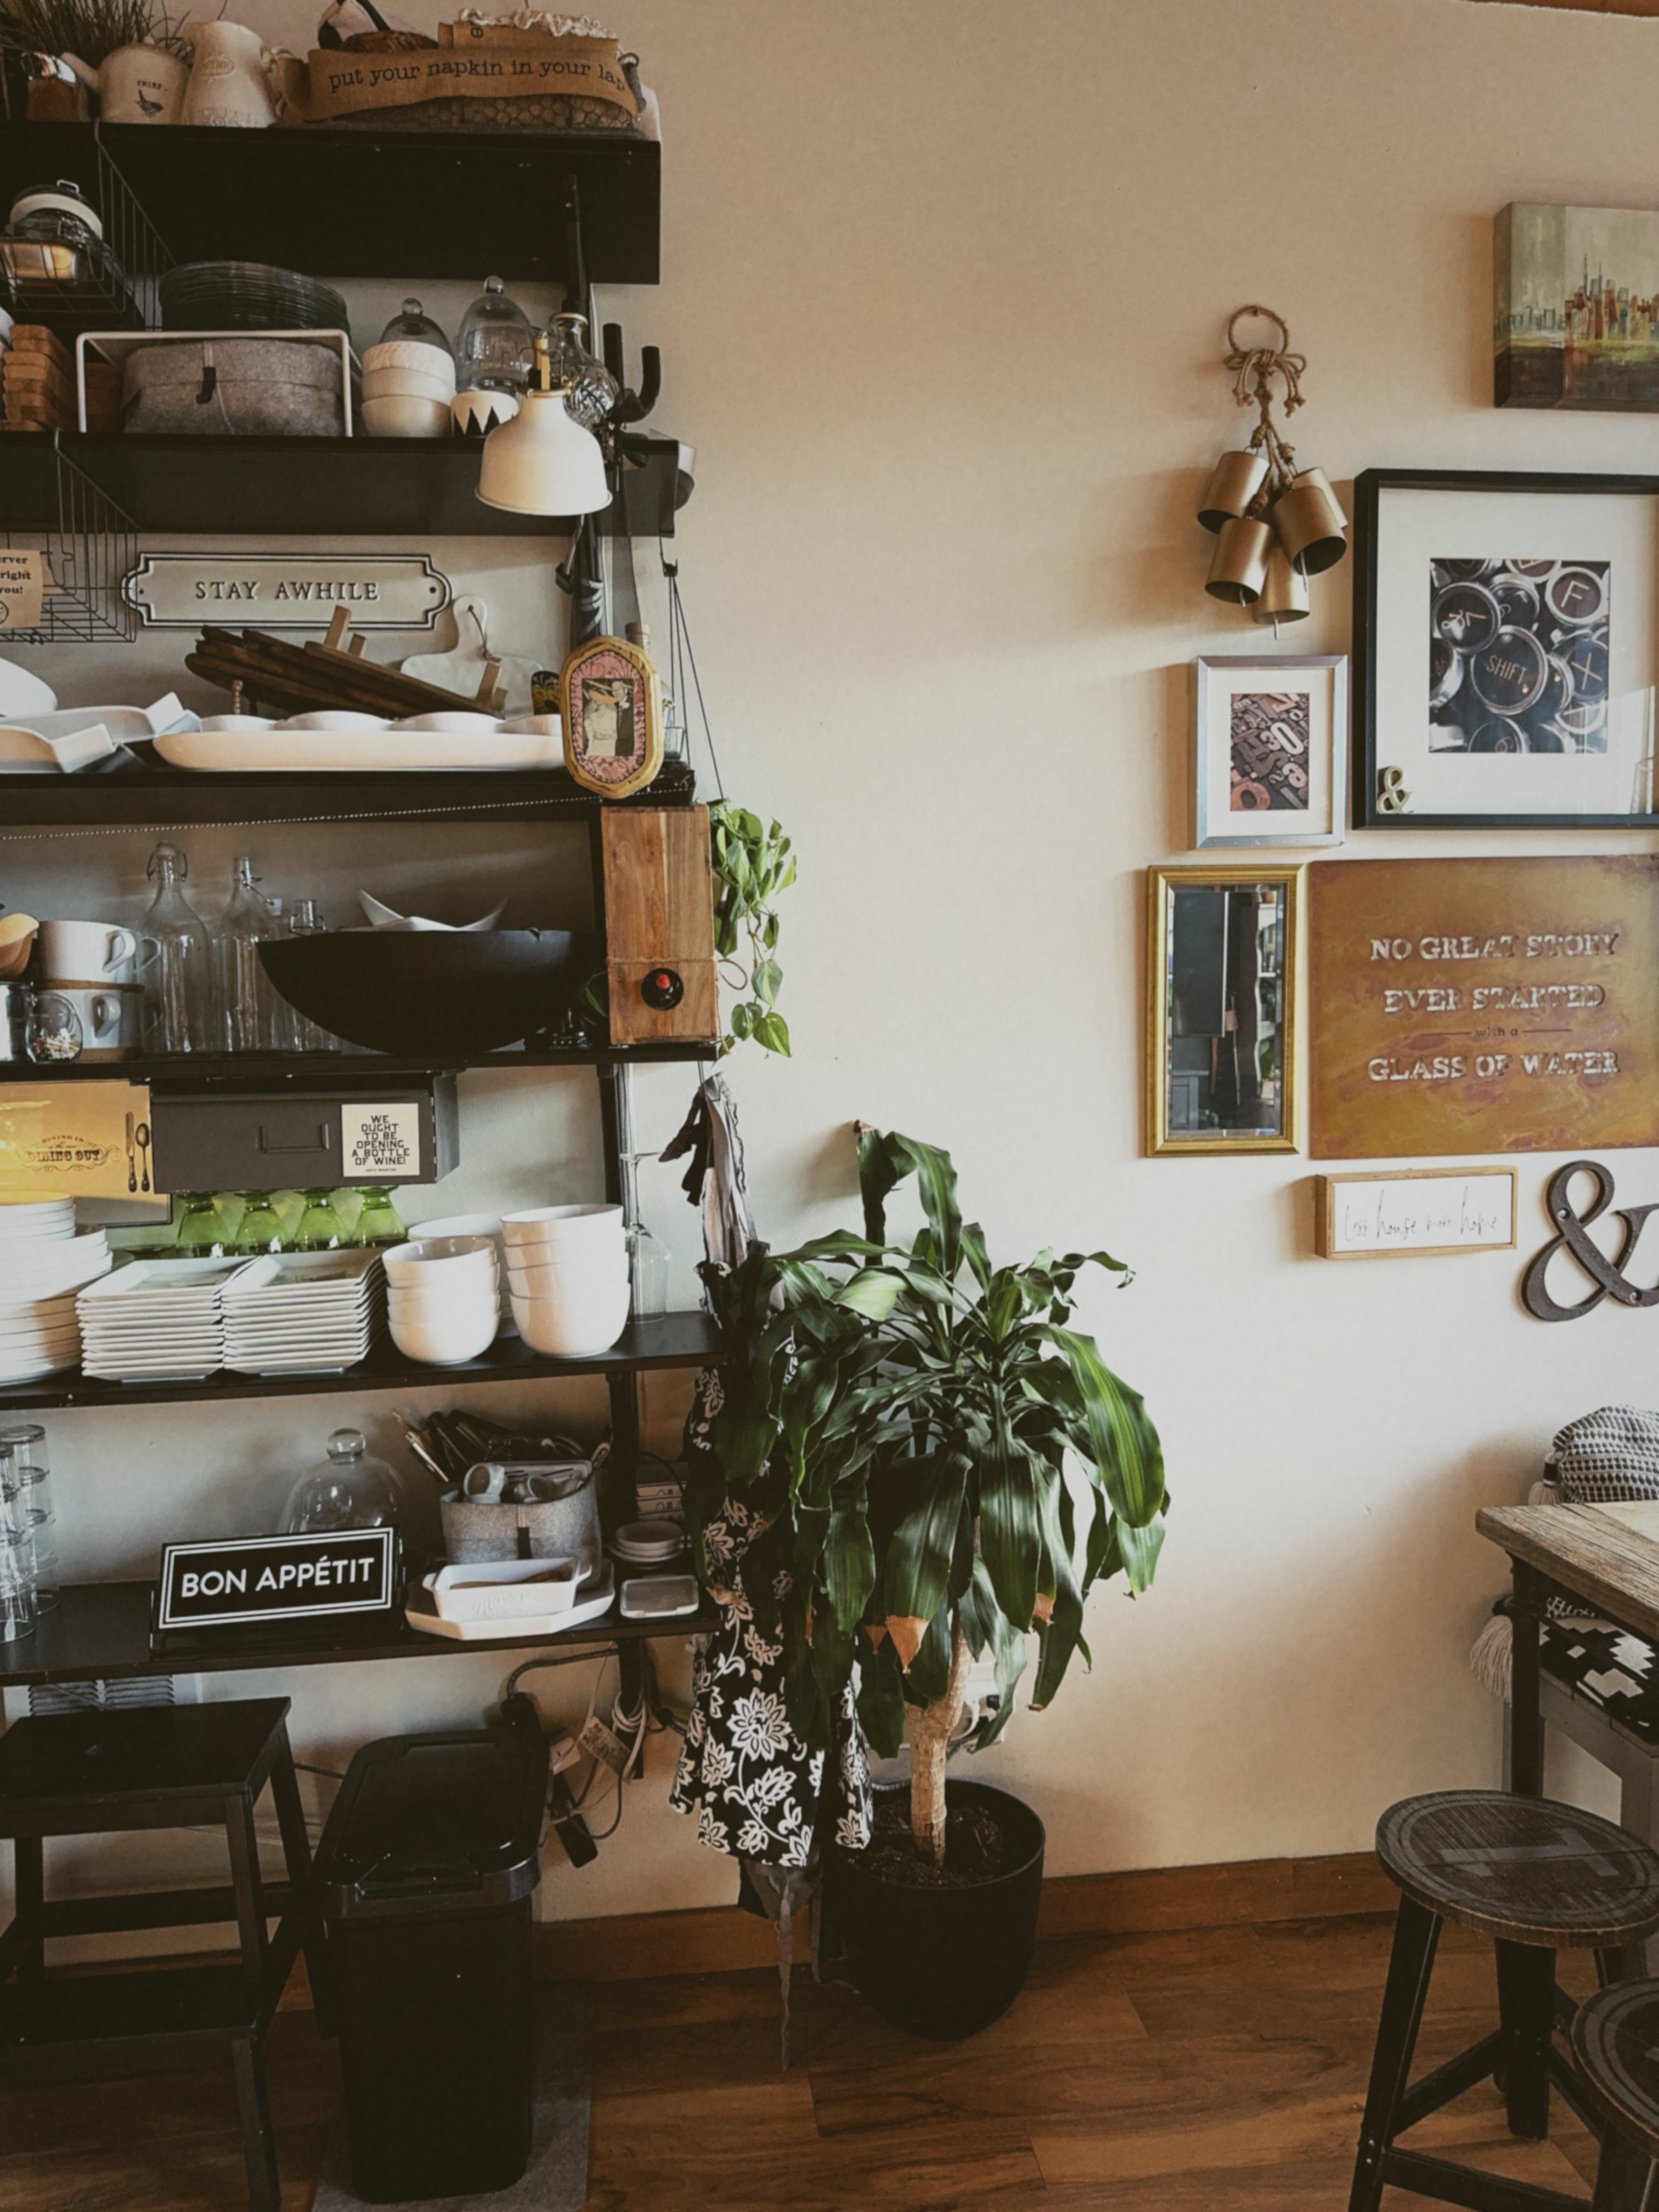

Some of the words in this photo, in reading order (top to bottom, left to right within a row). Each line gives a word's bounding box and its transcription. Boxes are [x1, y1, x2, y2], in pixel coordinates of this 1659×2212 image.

[329, 69, 363, 94] put
[370, 66, 420, 87] your
[427, 60, 503, 77] napkin
[511, 60, 533, 75] in
[539, 61, 590, 77] your
[195, 580, 258, 600] STAY
[275, 581, 379, 601] AWHILE
[1486, 654, 1527, 685] SHIFT
[1370, 937, 1413, 961] NO
[1419, 935, 1519, 960] GREAT
[1526, 933, 1619, 958] STORY
[1384, 988, 1463, 1013] EVER
[1472, 985, 1606, 1011] STARTED
[1510, 1028, 1518, 1037] a
[1367, 1055, 1468, 1082] GLASS
[1474, 1053, 1513, 1077] OF
[1520, 1050, 1621, 1076] WATER
[370, 1115, 389, 1123] WE
[361, 1123, 399, 1132] OUGHT
[42, 1135, 72, 1144] DINING
[364, 1132, 379, 1141] TO
[383, 1131, 397, 1140] BE
[357, 1140, 404, 1149] OPENING
[75, 1149, 100, 1161] OUT
[352, 1149, 358, 1158] A
[364, 1148, 410, 1157] BOTTLE
[355, 1157, 369, 1166] OF
[374, 1156, 406, 1165] WINE!
[181, 1568, 247, 1598] BON
[255, 1555, 375, 1592] APPÉTIT
